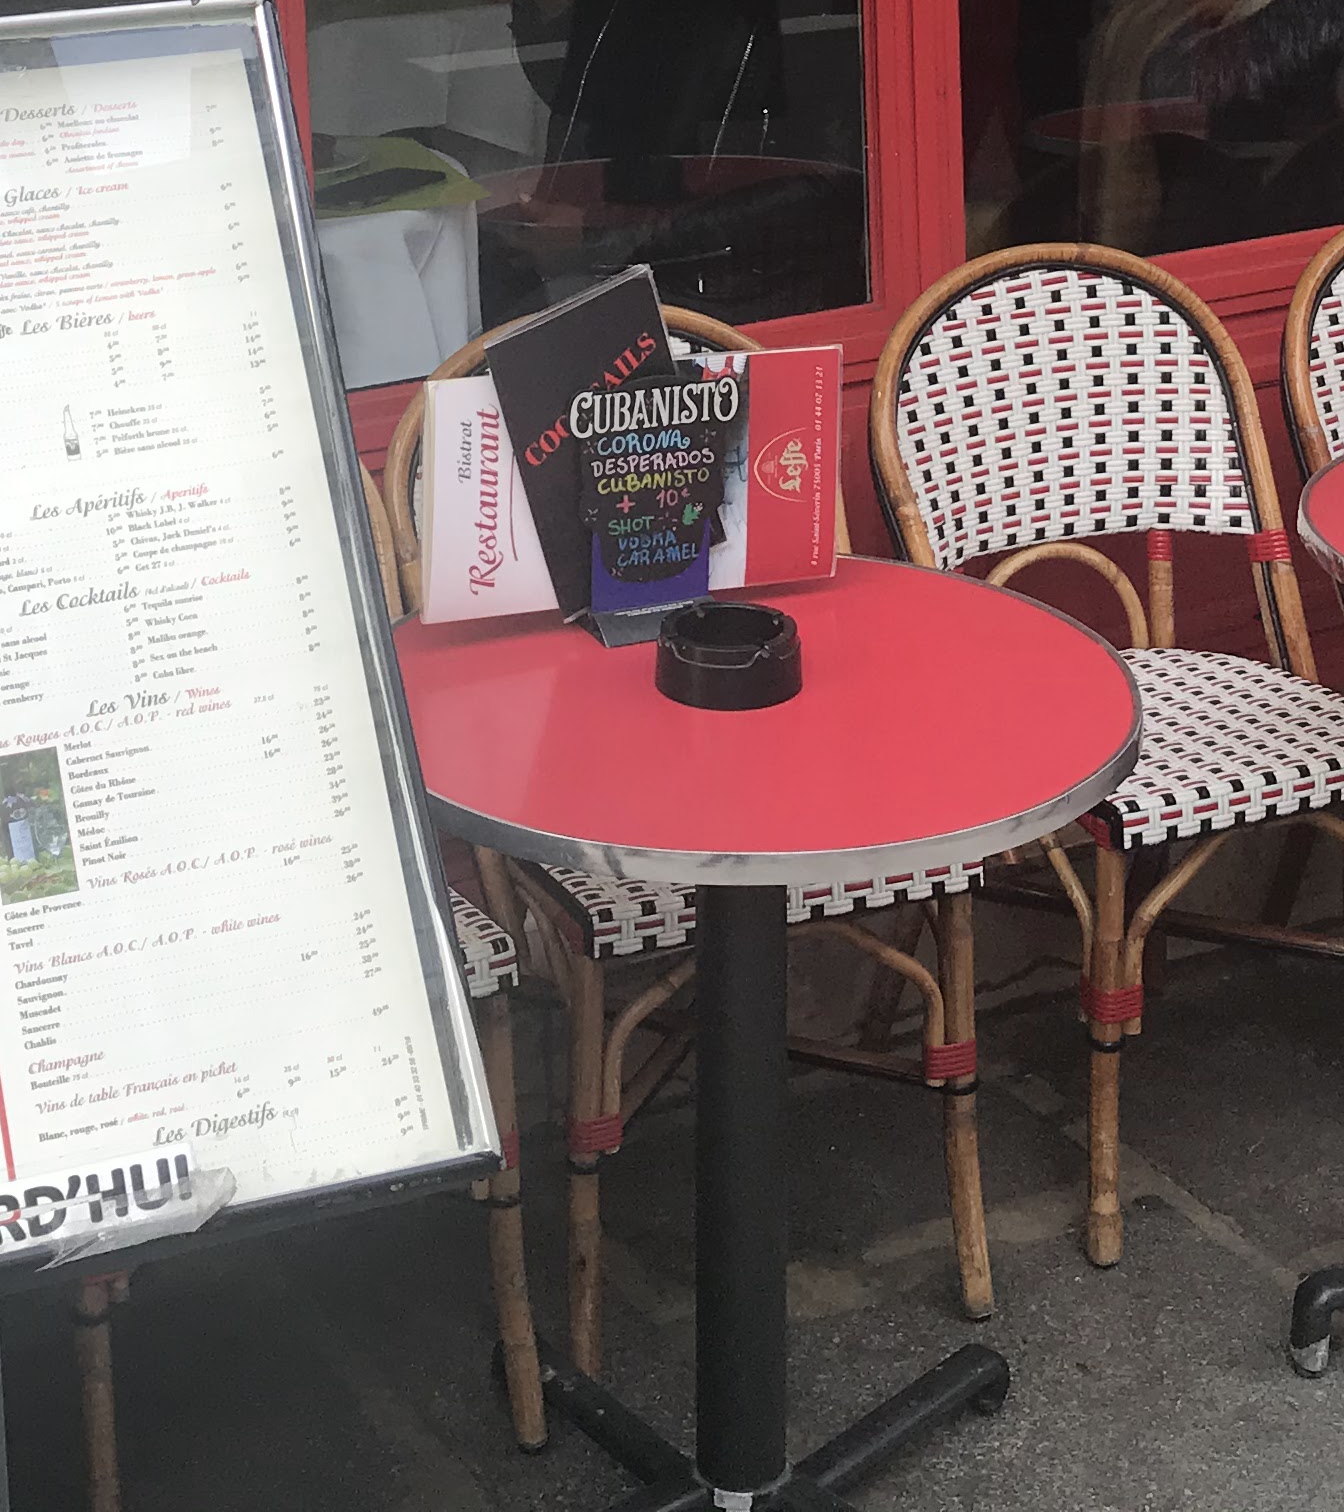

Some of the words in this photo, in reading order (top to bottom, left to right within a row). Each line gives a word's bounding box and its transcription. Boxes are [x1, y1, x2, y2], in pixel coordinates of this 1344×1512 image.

[0, 102, 77, 124] Desserts
[4, 186, 62, 207] Glaces
[19, 318, 52, 336] Les
[56, 311, 115, 331] Bières
[569, 377, 739, 439] CUBANISTO
[457, 418, 472, 484] Bistrot
[597, 429, 691, 456] CORONA
[814, 438, 822, 461] Paris
[591, 447, 715, 477] DESPERADOS
[779, 438, 808, 493] Leffe
[597, 467, 710, 495] CUBANISTO
[30, 501, 62, 521] Les
[65, 488, 147, 516] Apéritifs
[469, 403, 500, 596] Restaurant
[608, 516, 655, 536] SHOT
[617, 543, 699, 567] CARAMEL
[19, 598, 52, 616] Les
[56, 581, 140, 611] Cocktails
[85, 700, 119, 717] Les
[123, 689, 172, 709] Vins
[13, 730, 61, 747] Rouges
[87, 875, 118, 890] Vins
[14, 960, 45, 975] Vins
[51, 950, 94, 968] Blancs
[28, 1050, 105, 1076] Champagne
[124, 1073, 179, 1098] Français
[153, 1124, 186, 1147] Les
[190, 1101, 280, 1138] Digestifs
